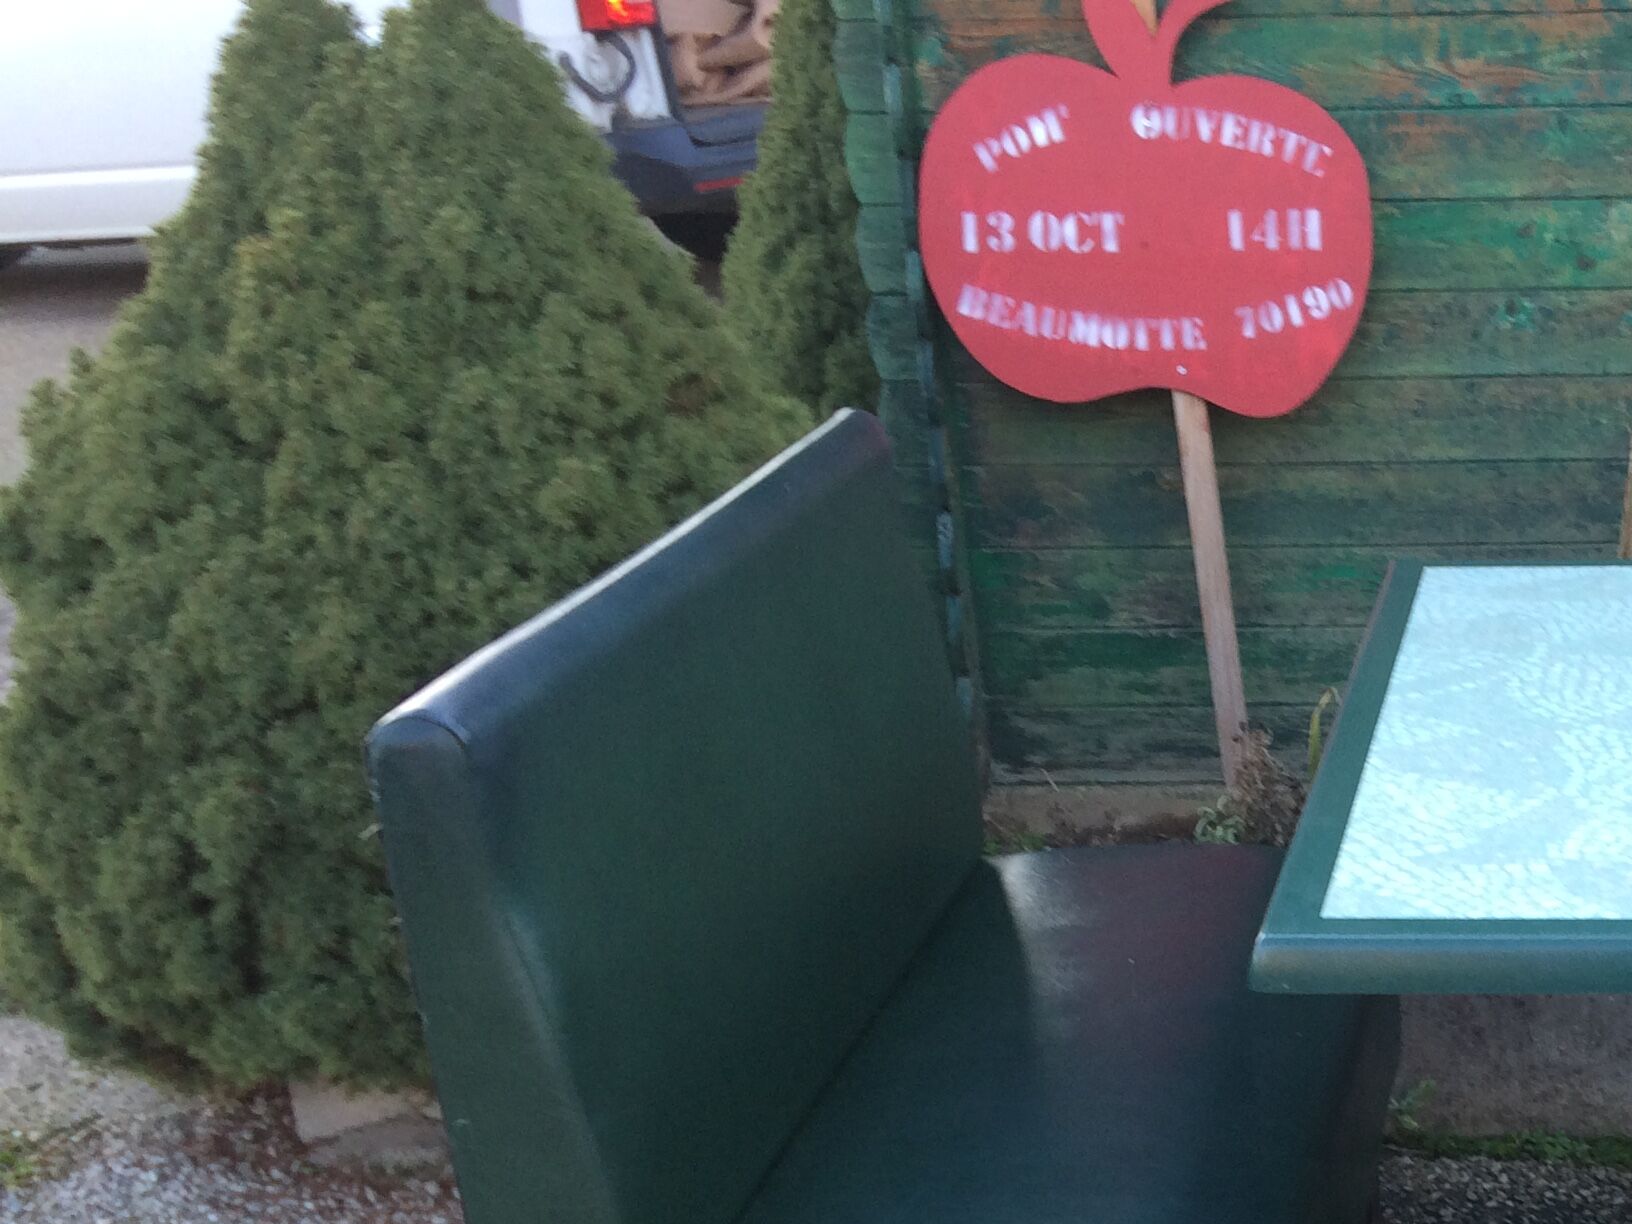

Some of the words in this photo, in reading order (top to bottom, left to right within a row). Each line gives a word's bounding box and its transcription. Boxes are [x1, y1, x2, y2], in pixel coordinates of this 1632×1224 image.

[1130, 102, 1334, 178] OUVERTE
[960, 211, 1017, 254] 13
[1028, 210, 1125, 253] OCT
[1227, 208, 1322, 252] 14H
[956, 284, 1208, 351] BEAUMOTTE
[1234, 278, 1354, 339] 70190
